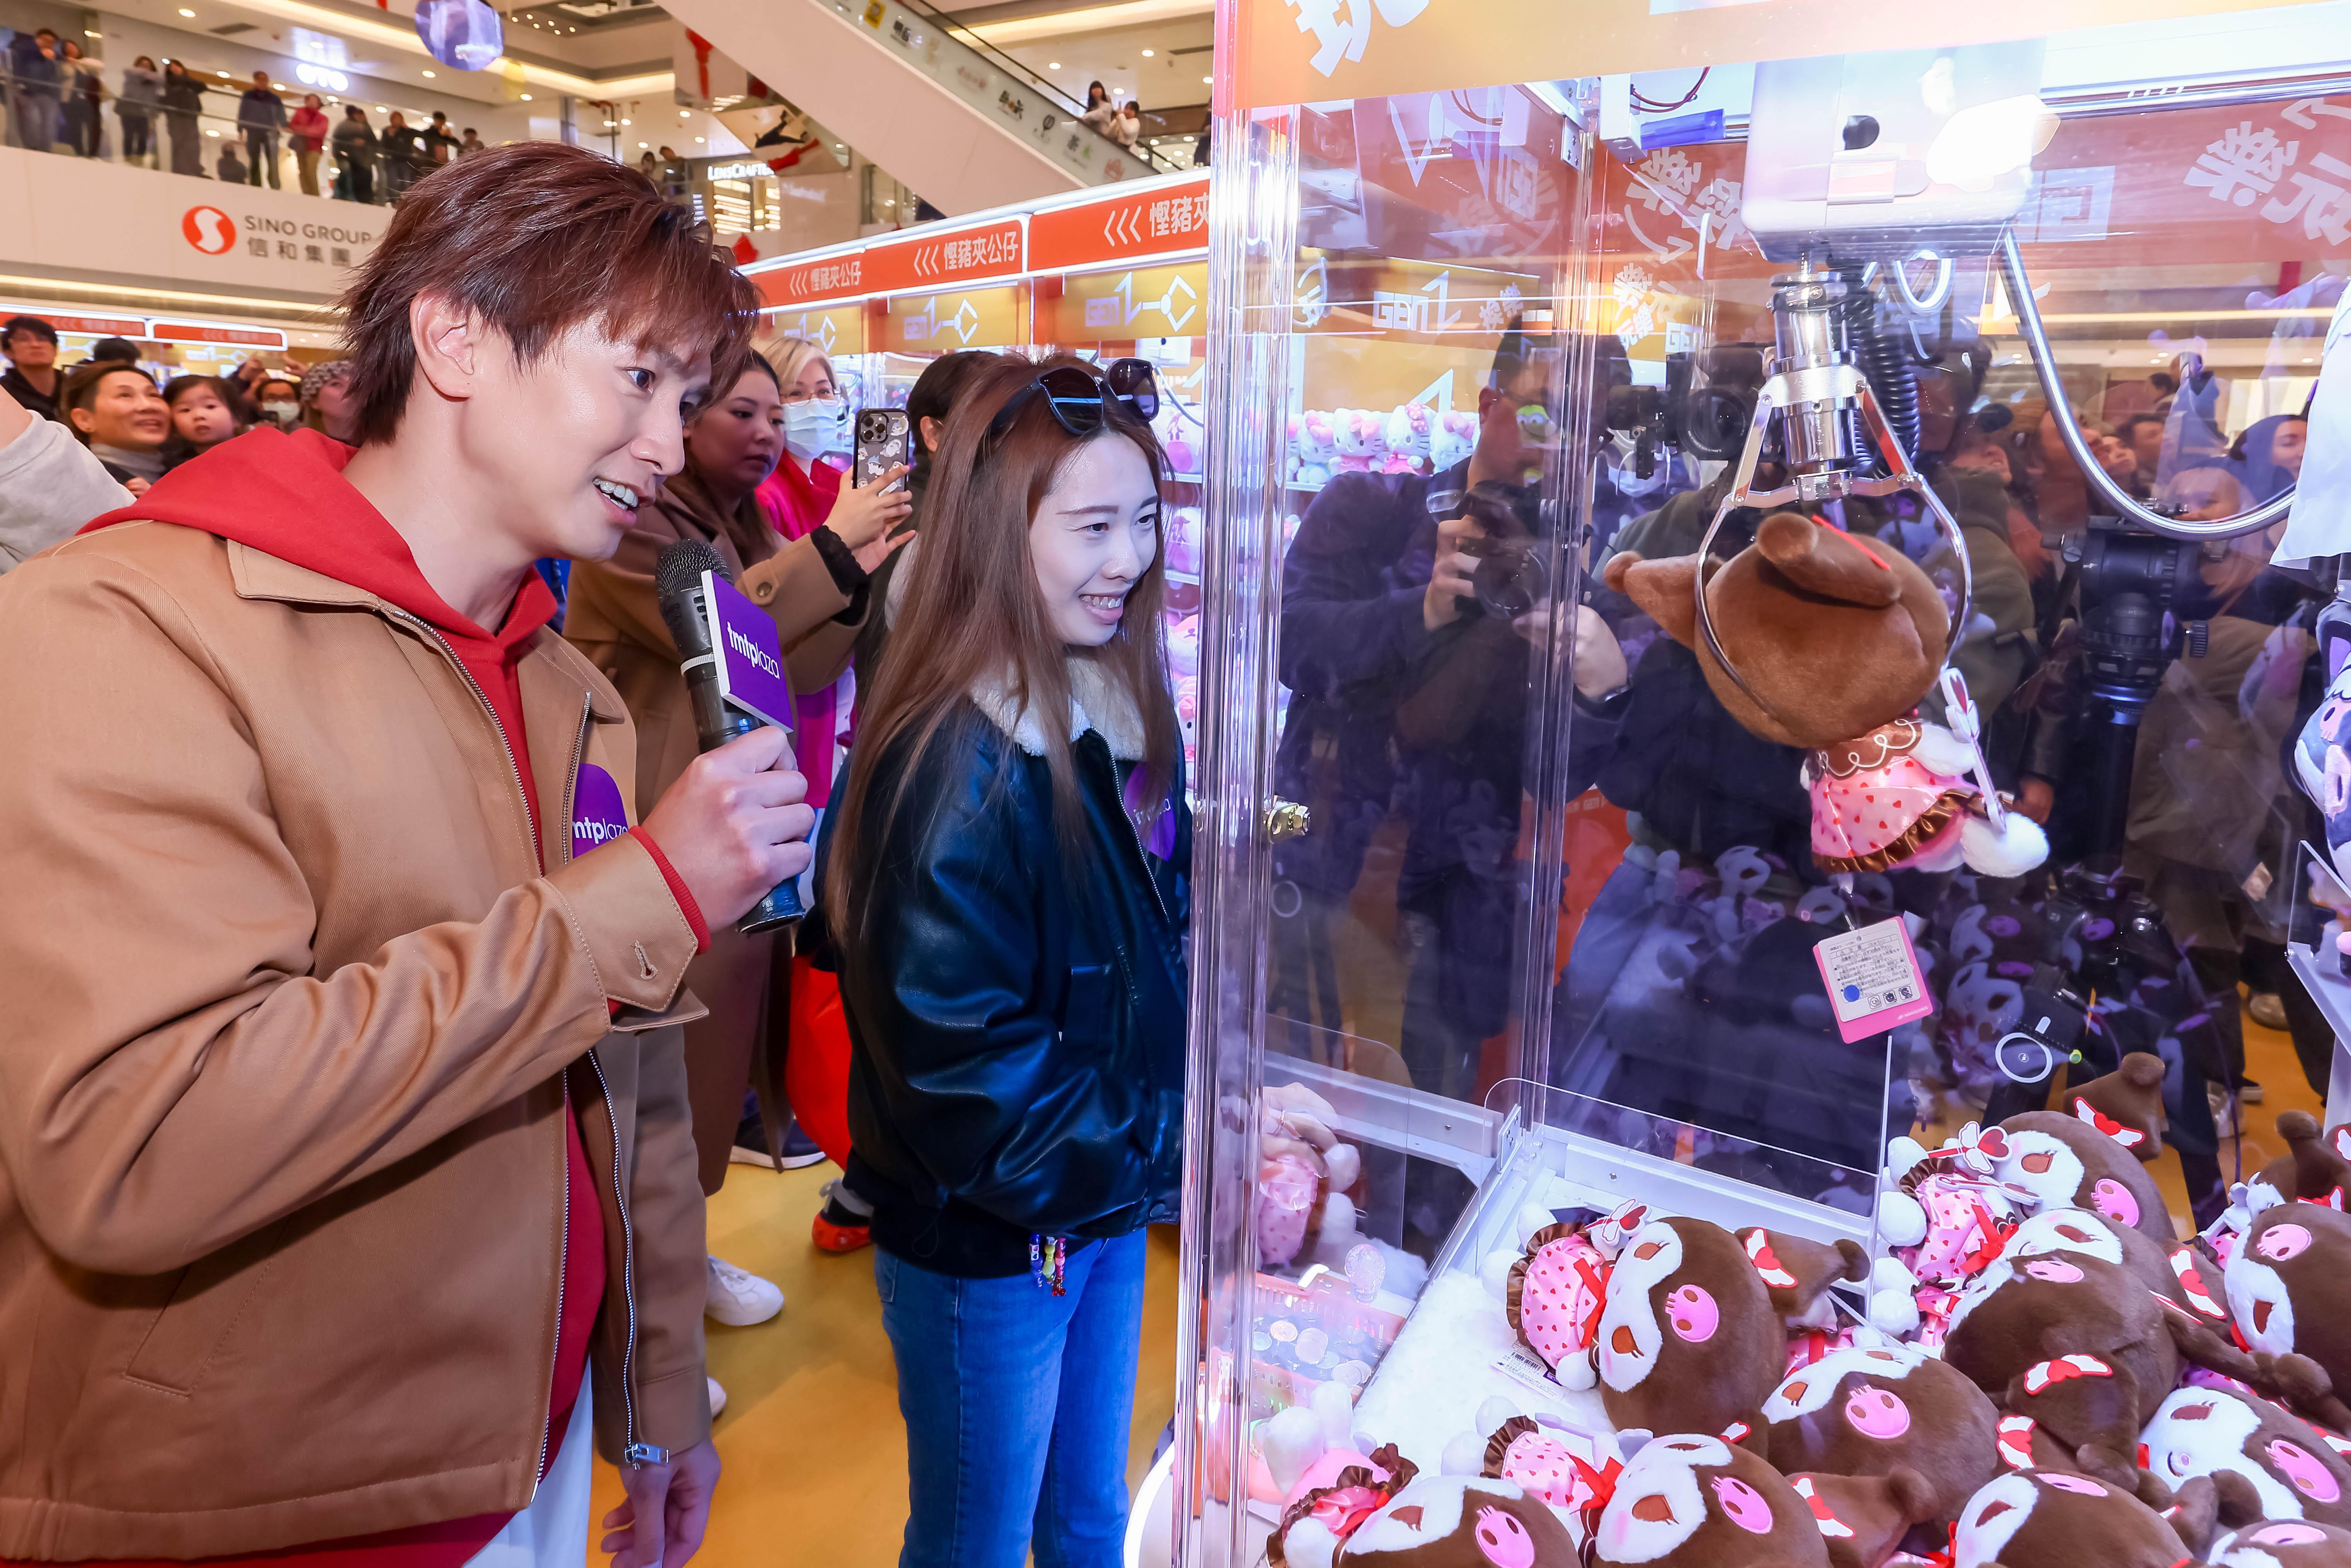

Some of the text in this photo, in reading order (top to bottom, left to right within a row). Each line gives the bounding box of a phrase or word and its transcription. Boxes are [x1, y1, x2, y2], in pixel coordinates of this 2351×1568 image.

[244, 215, 372, 244] SINO GROUP
[727, 621, 780, 681] tmtplaza
